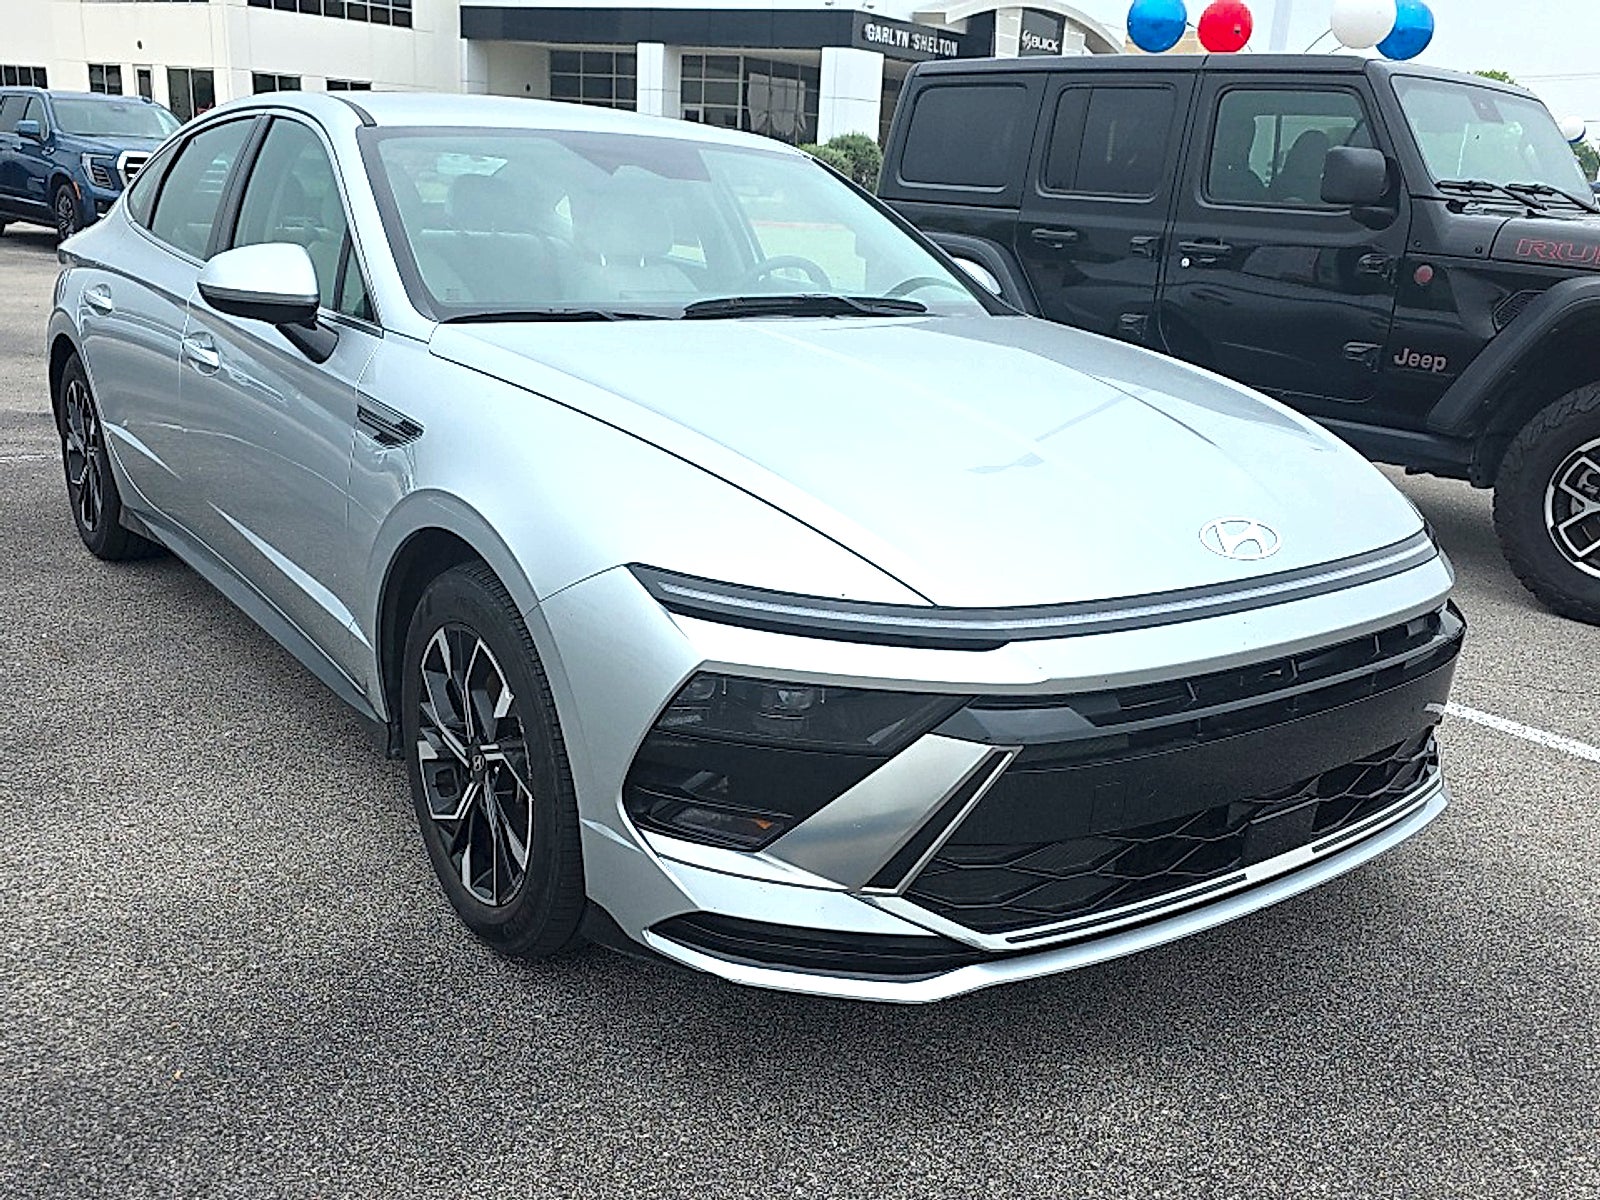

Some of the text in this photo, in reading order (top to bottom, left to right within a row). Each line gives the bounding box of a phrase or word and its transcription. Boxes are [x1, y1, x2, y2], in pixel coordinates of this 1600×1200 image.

[865, 23, 958, 57] GARLYN SHELTON
[1032, 36, 1059, 53] BUICK
[1393, 347, 1447, 373] Jeep
